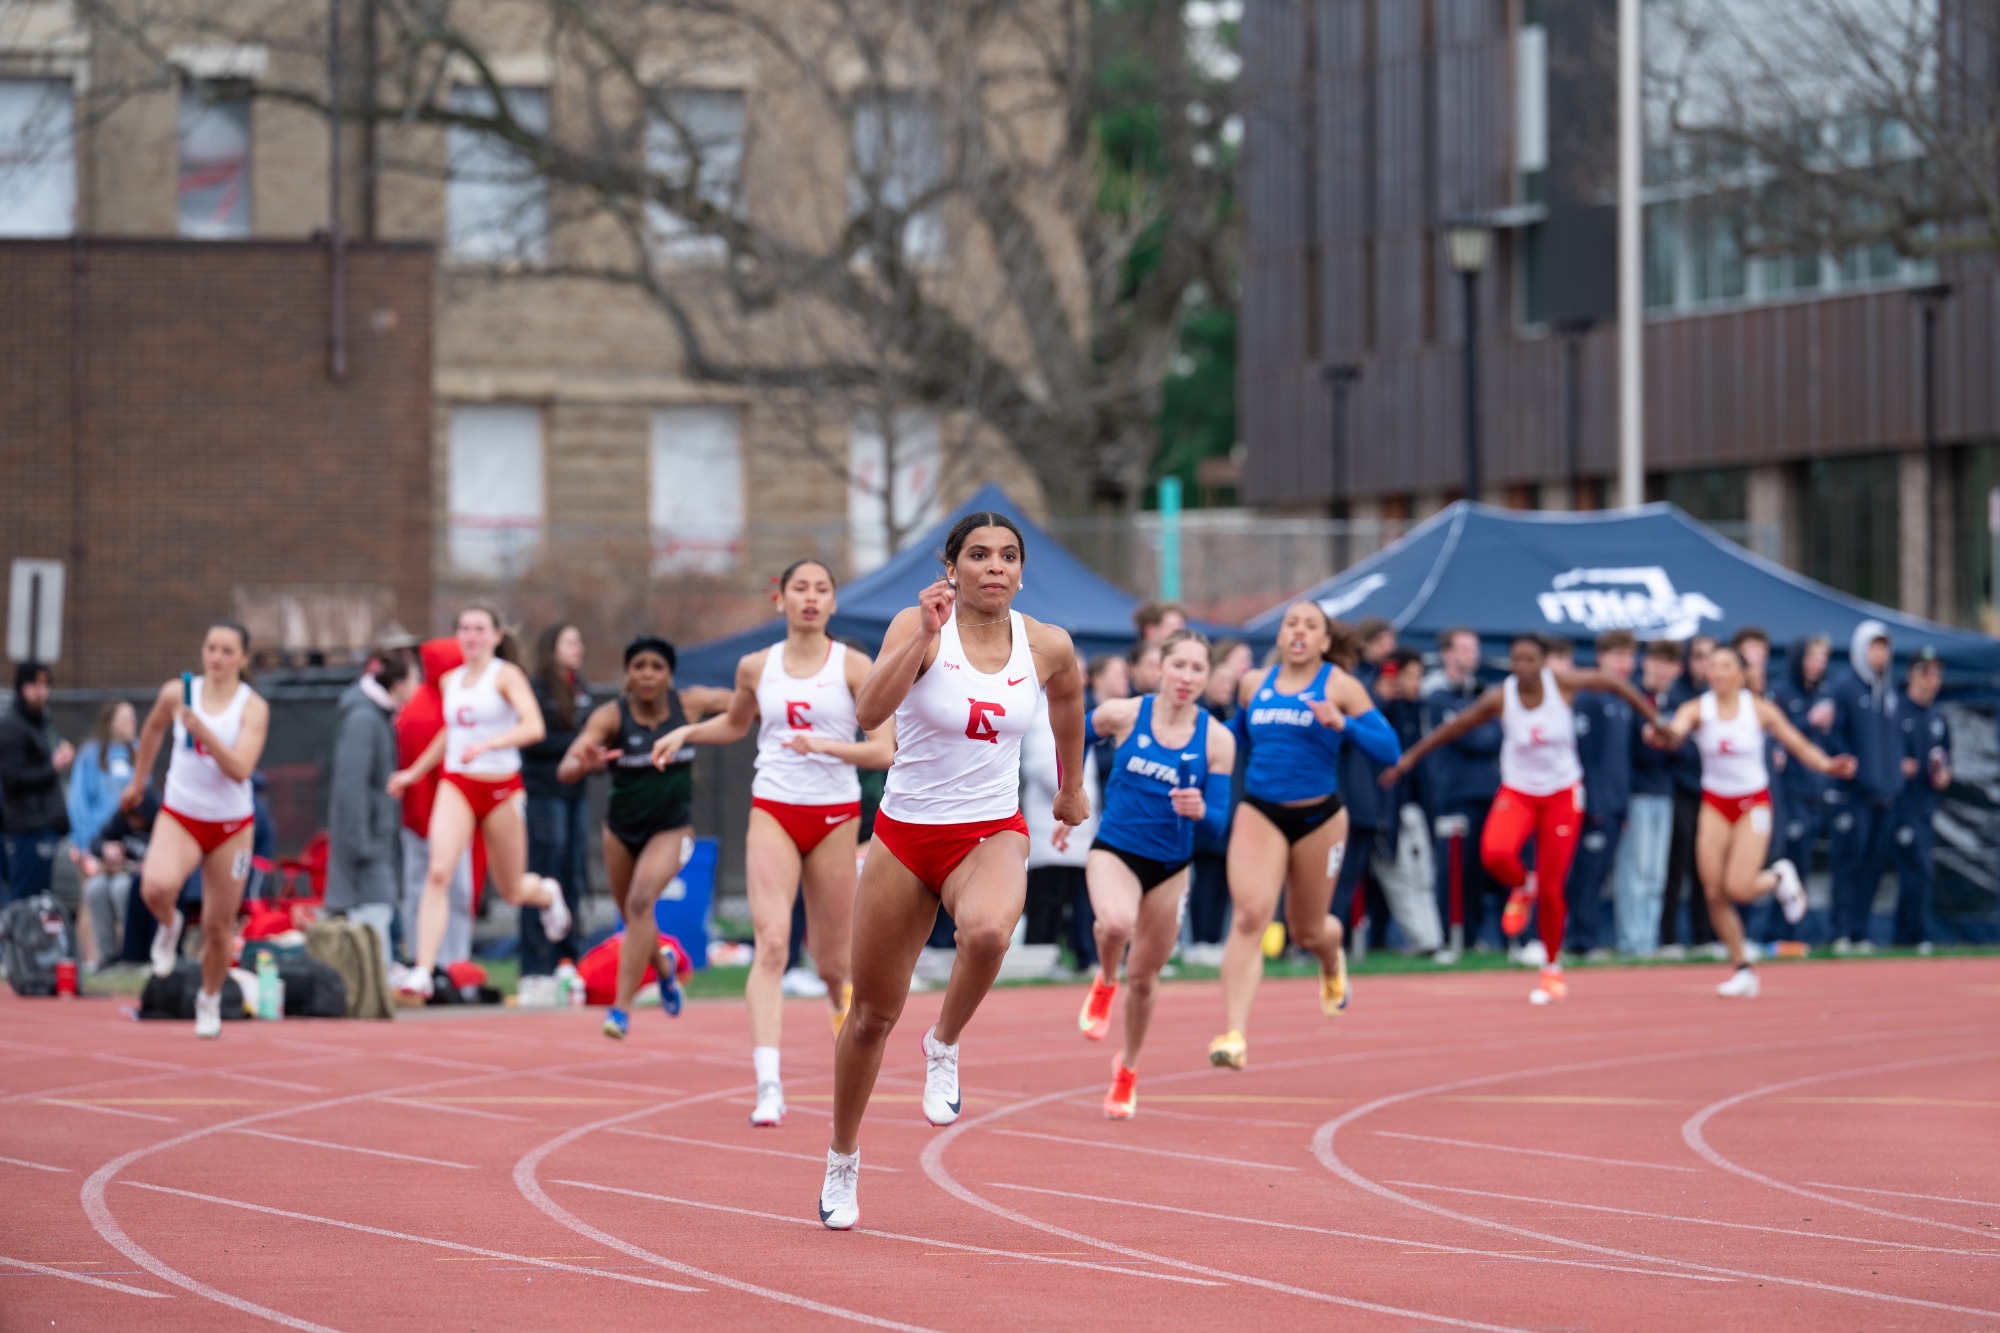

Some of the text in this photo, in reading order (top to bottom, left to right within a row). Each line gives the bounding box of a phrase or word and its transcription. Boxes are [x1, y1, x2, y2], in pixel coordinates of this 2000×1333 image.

[943, 661, 955, 671] Ivy
[965, 698, 1006, 744] C
[1250, 707, 1315, 727] BUFFALO
[1125, 756, 1197, 787] BUFFA
